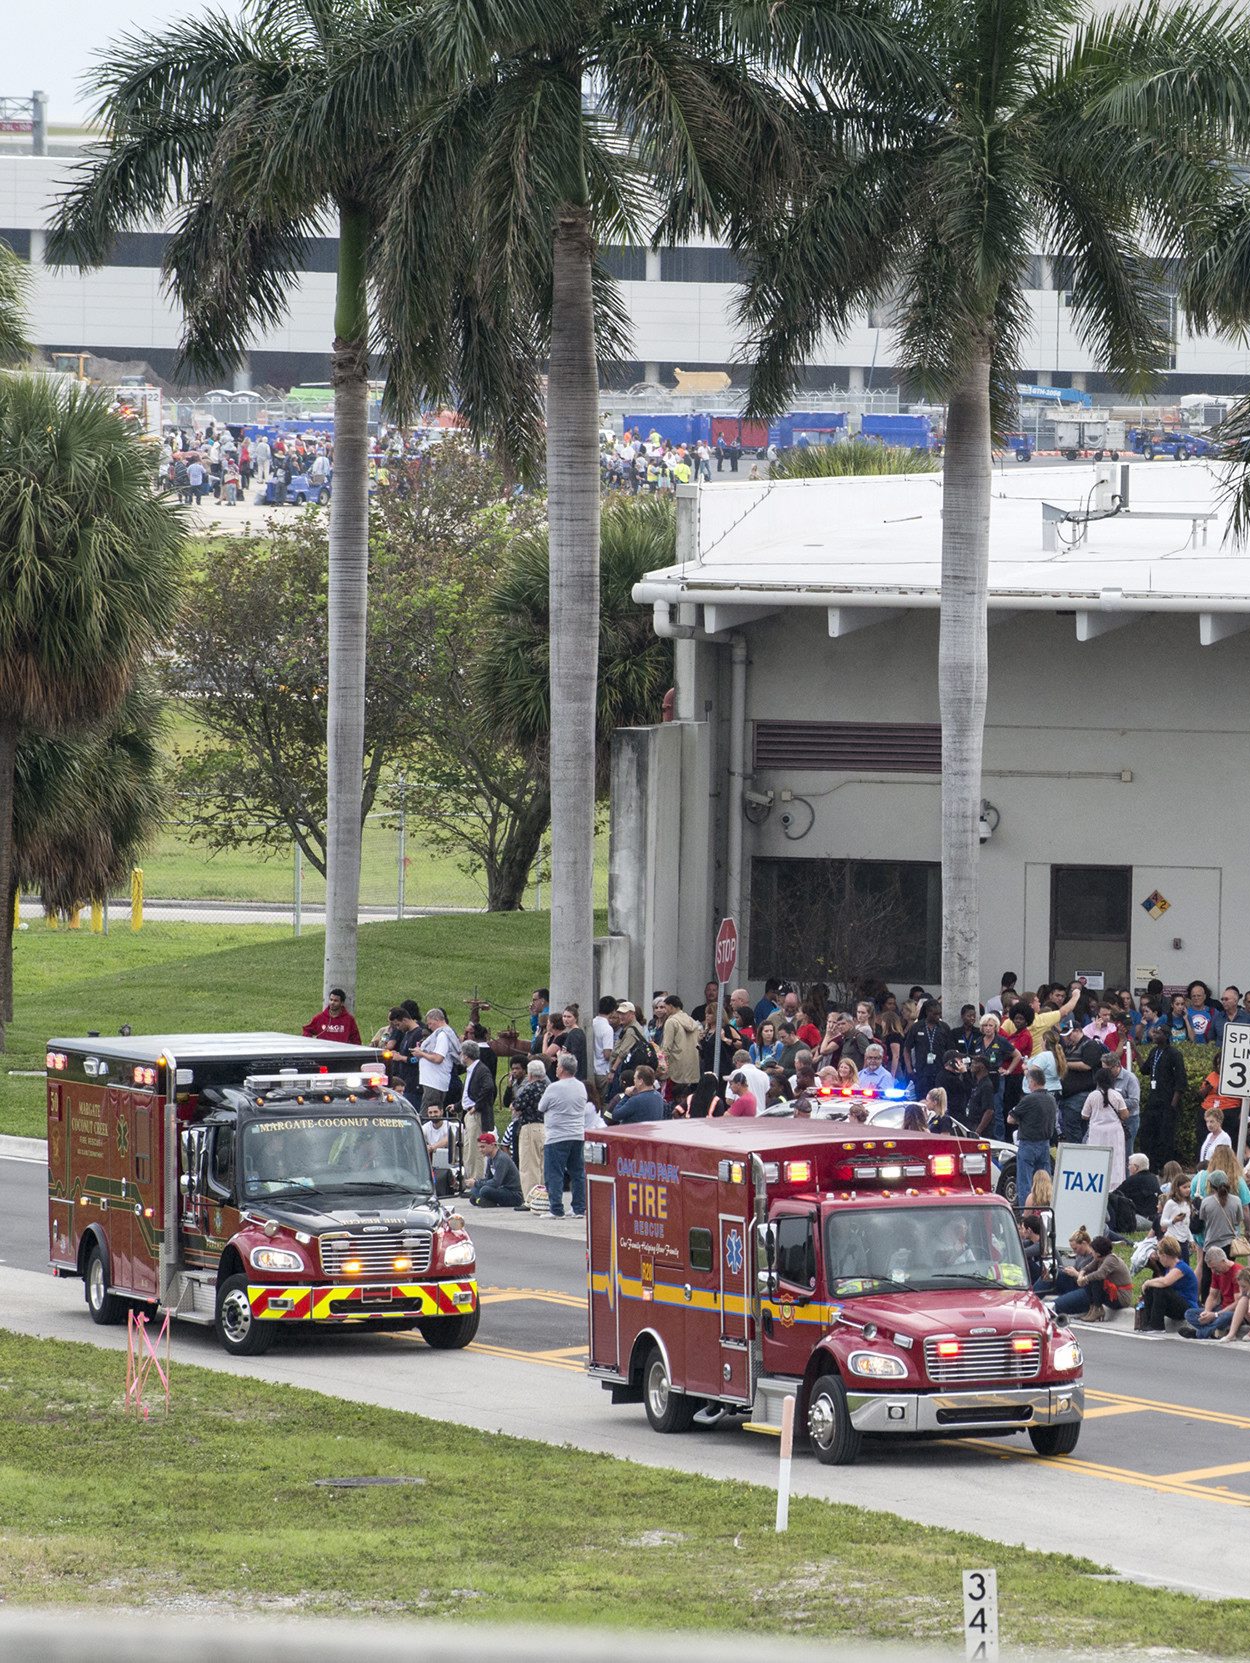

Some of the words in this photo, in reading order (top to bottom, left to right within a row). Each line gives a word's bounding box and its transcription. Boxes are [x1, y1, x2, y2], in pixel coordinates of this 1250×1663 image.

[1160, 899, 1167, 909] 2
[716, 937, 736, 964] STOP
[78, 1101, 101, 1118] MARGATE
[71, 1118, 93, 1134] COCONUT
[93, 1122, 109, 1137] CREEK
[259, 1117, 369, 1133] MARGATE-COCONUT
[372, 1118, 405, 1128] CREEK
[617, 1157, 656, 1181] OAKLAND
[657, 1162, 680, 1184] PARK
[1062, 1170, 1105, 1193] TAXI
[628, 1181, 668, 1220] FIRE
[633, 1219, 665, 1239] RESCUE
[627, 1238, 641, 1253] Family
[664, 1244, 679, 1258] Family
